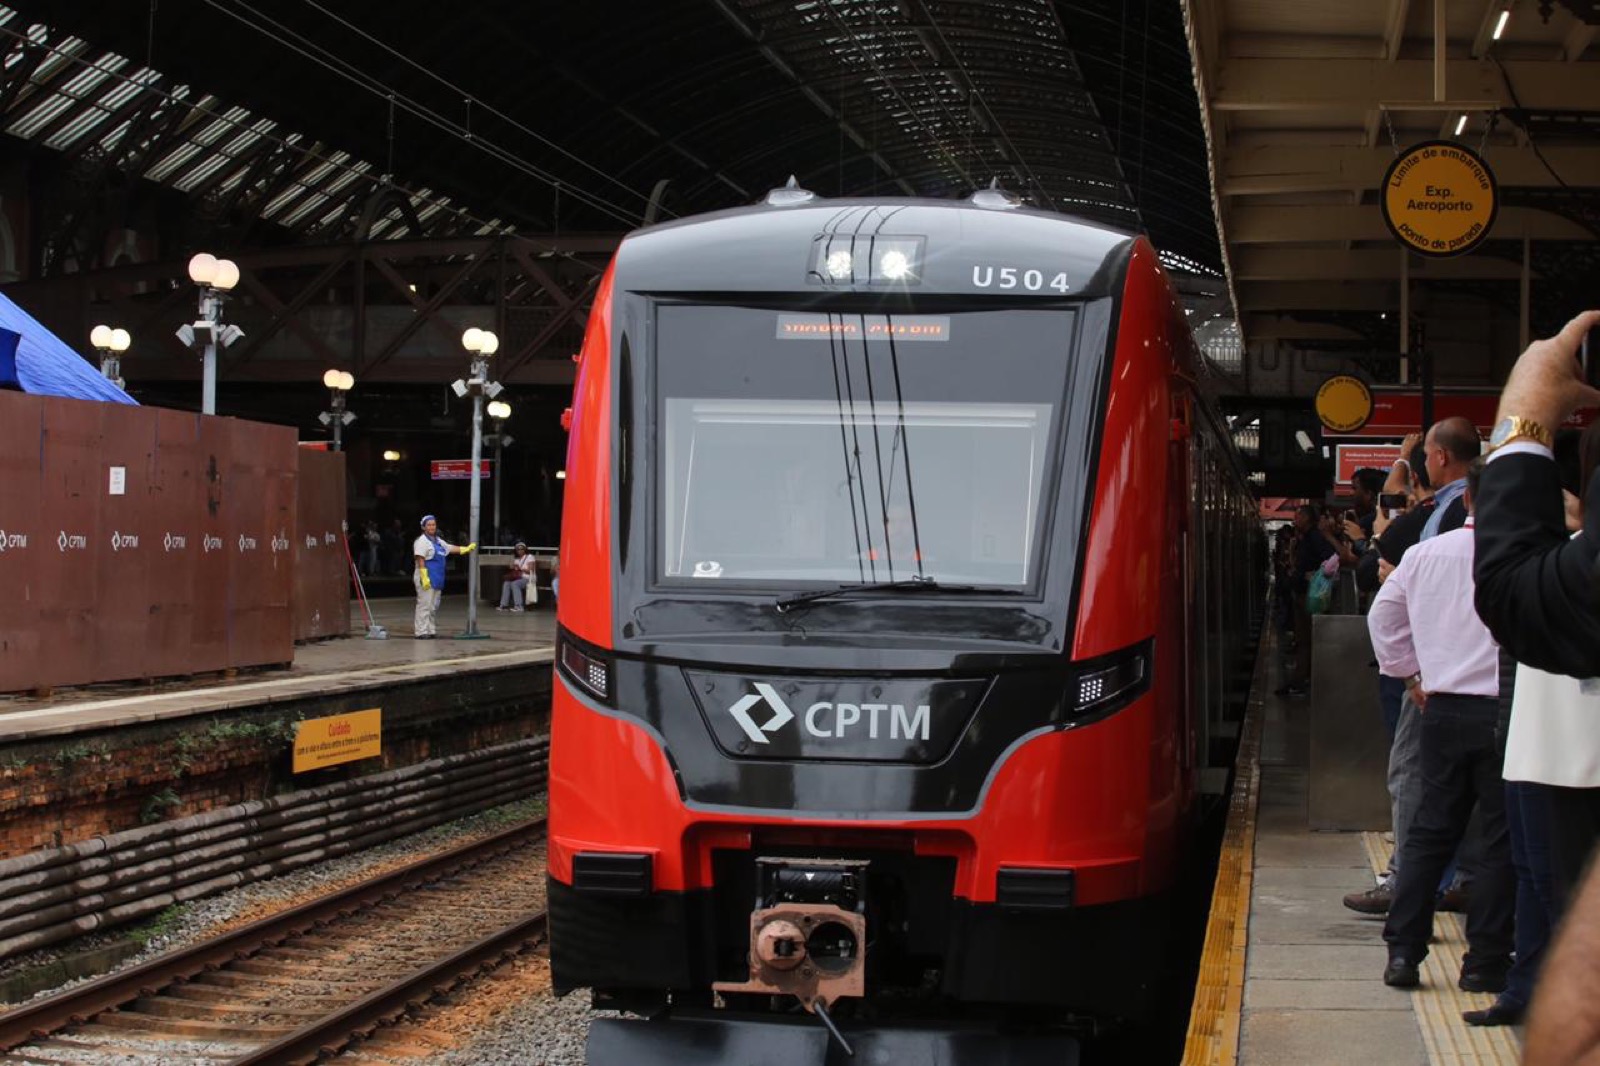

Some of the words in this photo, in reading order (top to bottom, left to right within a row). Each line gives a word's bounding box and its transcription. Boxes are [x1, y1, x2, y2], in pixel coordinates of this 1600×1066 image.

[1391, 155, 1420, 188] Limite
[1422, 148, 1437, 160] de
[1441, 148, 1490, 190] embarque
[1425, 186, 1454, 198] Exp.
[1407, 200, 1473, 213] Aeroporto
[1399, 223, 1429, 247] ponto
[1431, 238, 1446, 249] de
[1448, 222, 1482, 250] parada
[972, 265, 1070, 293] U504
[8, 534, 27, 548] CPTM
[68, 535, 86, 549] CPTM
[121, 535, 138, 548] CPTM
[171, 536, 186, 549] CPTM
[804, 702, 931, 740] CPTM
